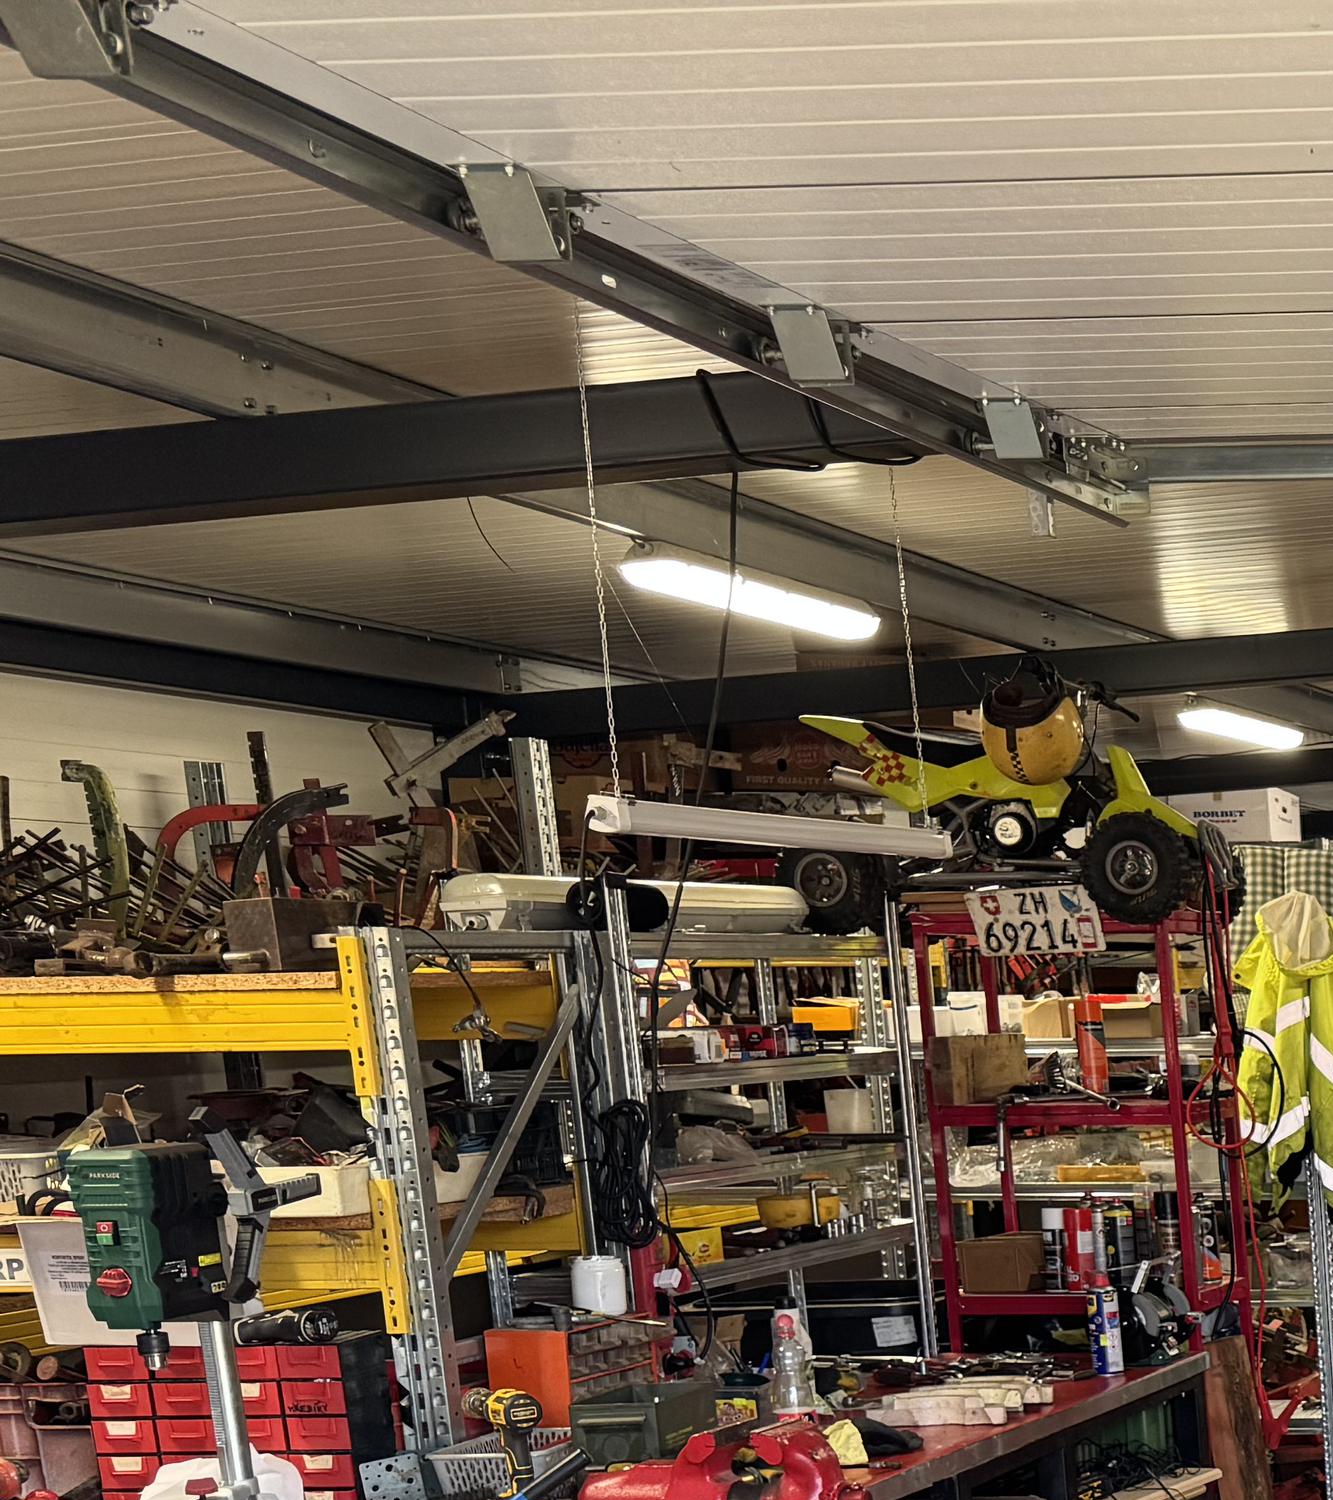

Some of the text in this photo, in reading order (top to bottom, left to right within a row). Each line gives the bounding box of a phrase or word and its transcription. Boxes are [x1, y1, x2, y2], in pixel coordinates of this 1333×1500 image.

[746, 775, 774, 784] FIRST
[1193, 809, 1246, 818] BORBET
[1013, 891, 1048, 915] ZH
[985, 918, 1079, 953] 69214
